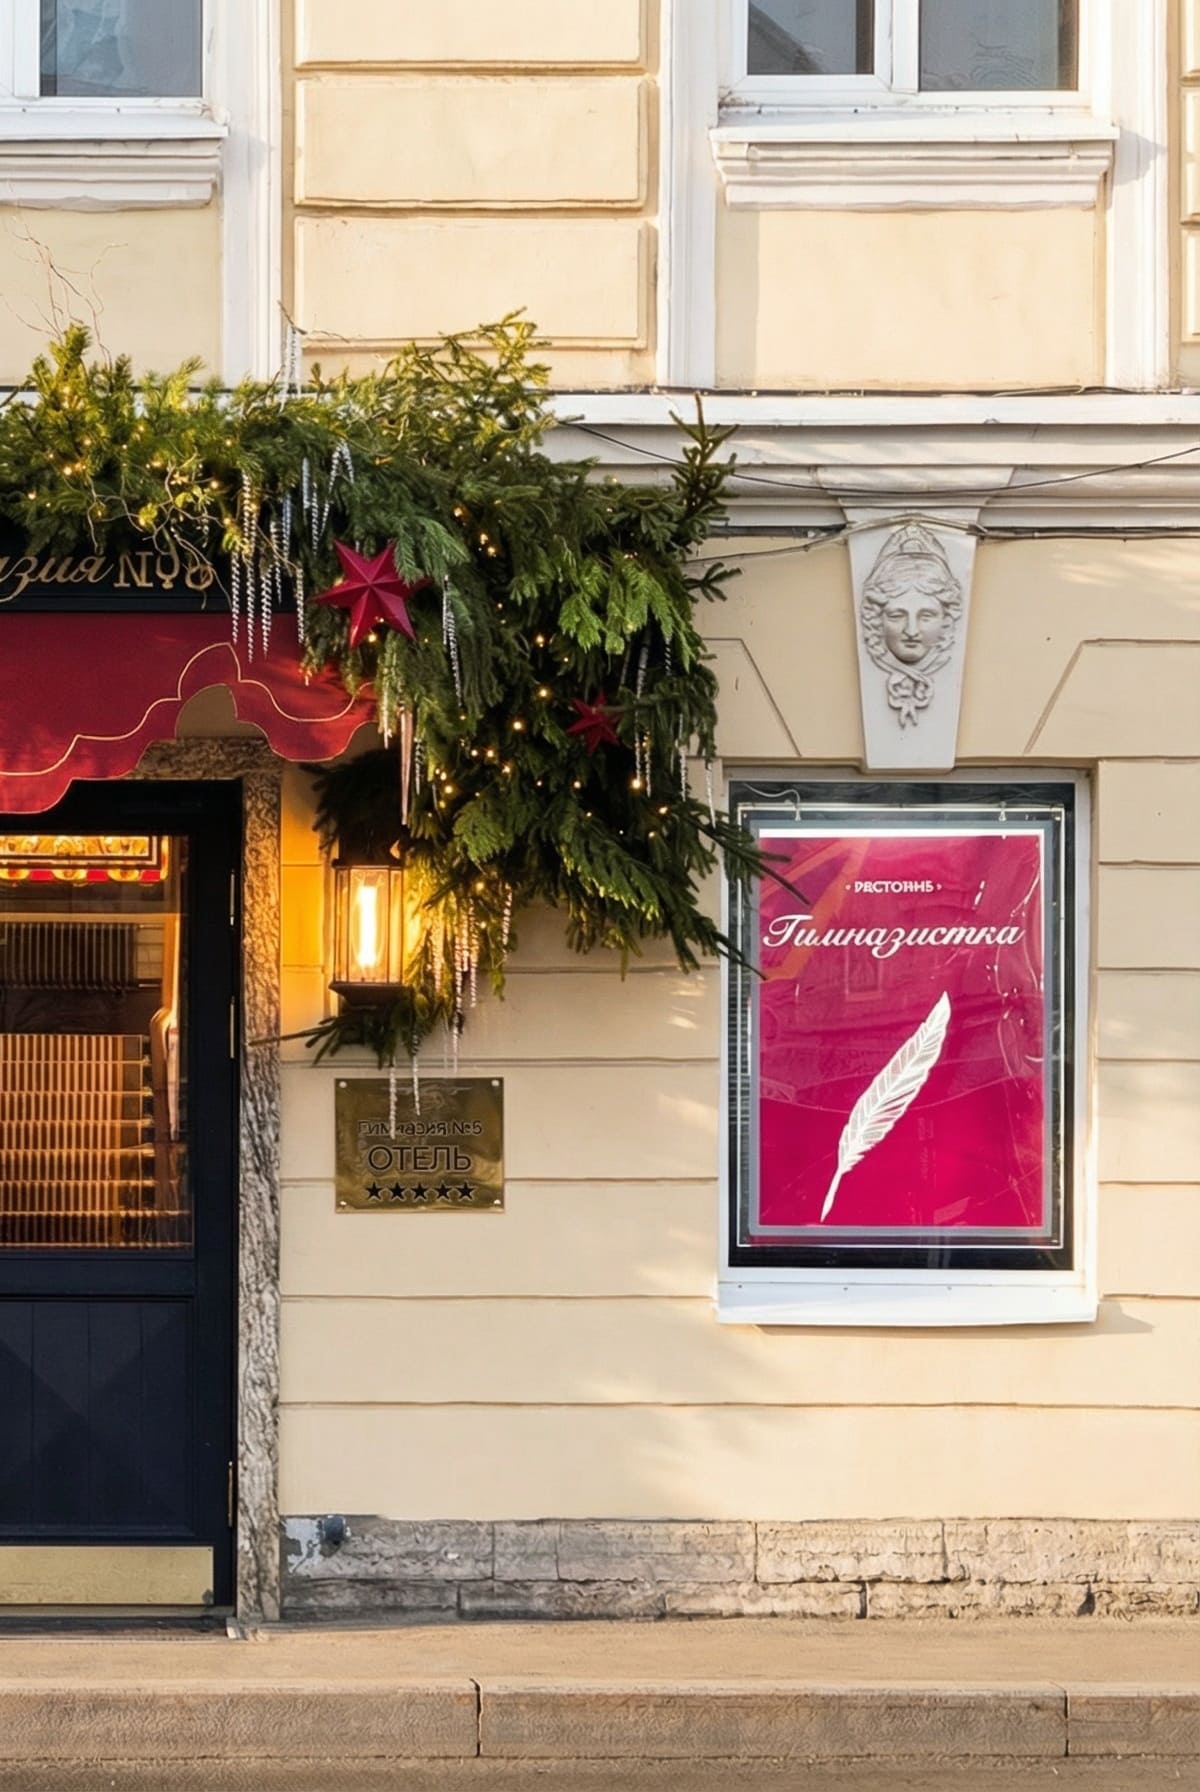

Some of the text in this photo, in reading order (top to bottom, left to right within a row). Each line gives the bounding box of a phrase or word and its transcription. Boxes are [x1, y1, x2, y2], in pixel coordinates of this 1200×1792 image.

[763, 914, 1026, 959] Гимназистка
[452, 1120, 483, 1135] №5
[368, 1145, 472, 1171] ОТЕЛЬ
